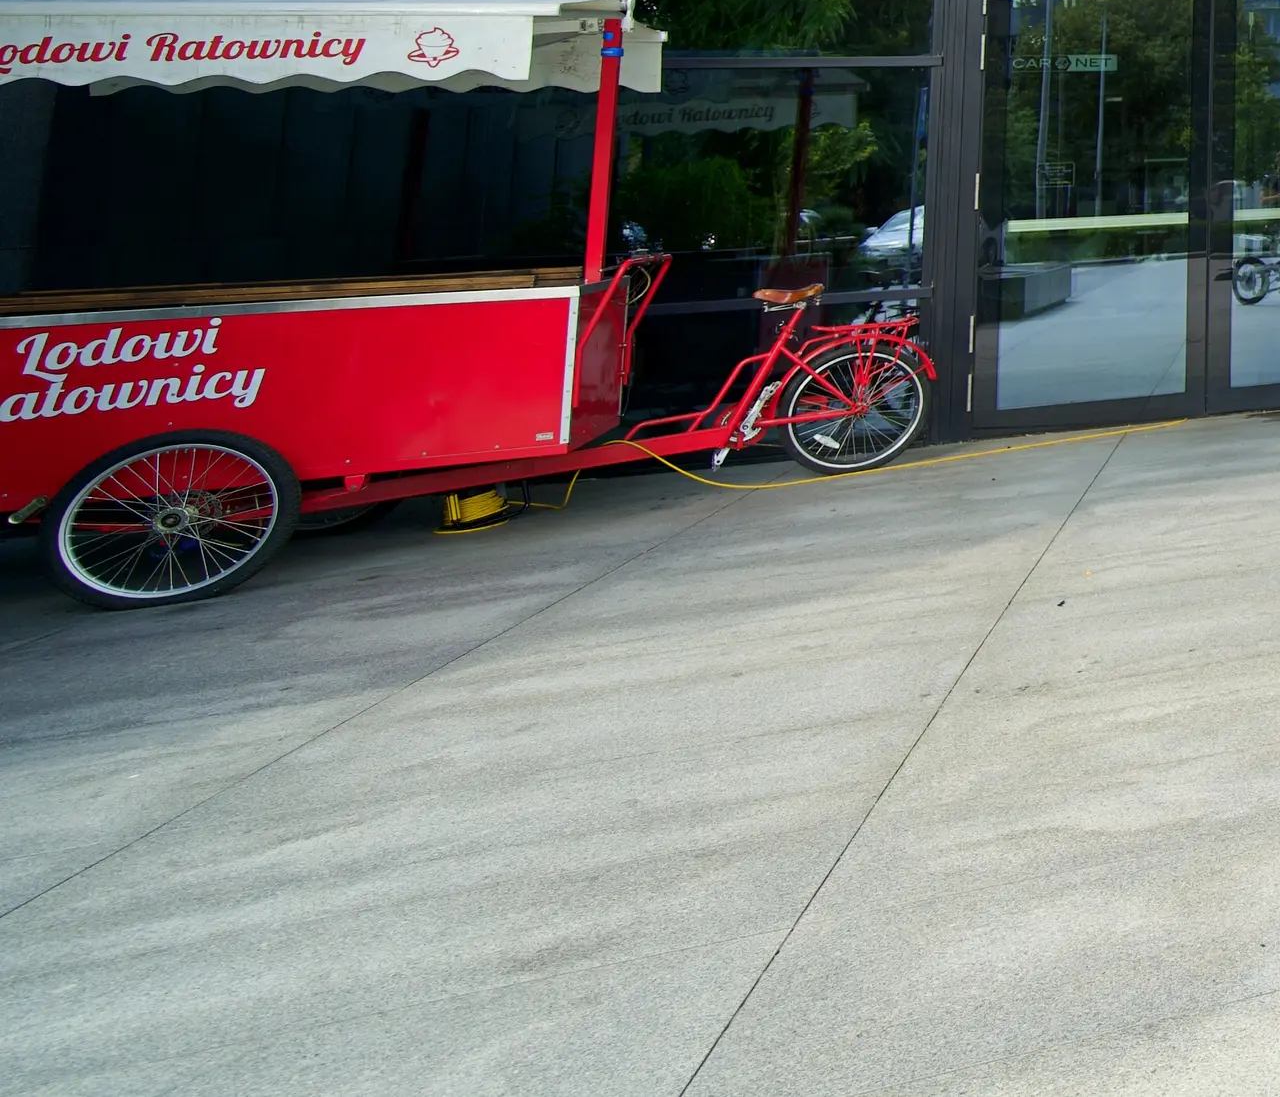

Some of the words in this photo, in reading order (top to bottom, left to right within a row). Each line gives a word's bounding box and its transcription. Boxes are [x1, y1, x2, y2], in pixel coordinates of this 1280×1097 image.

[0, 33, 131, 74] odowi
[146, 31, 366, 66] Ratownicy
[1012, 58, 1051, 69] CAR
[1075, 57, 1112, 68] NET
[16, 317, 222, 383] Lodowi
[0, 364, 266, 422] atownicy
